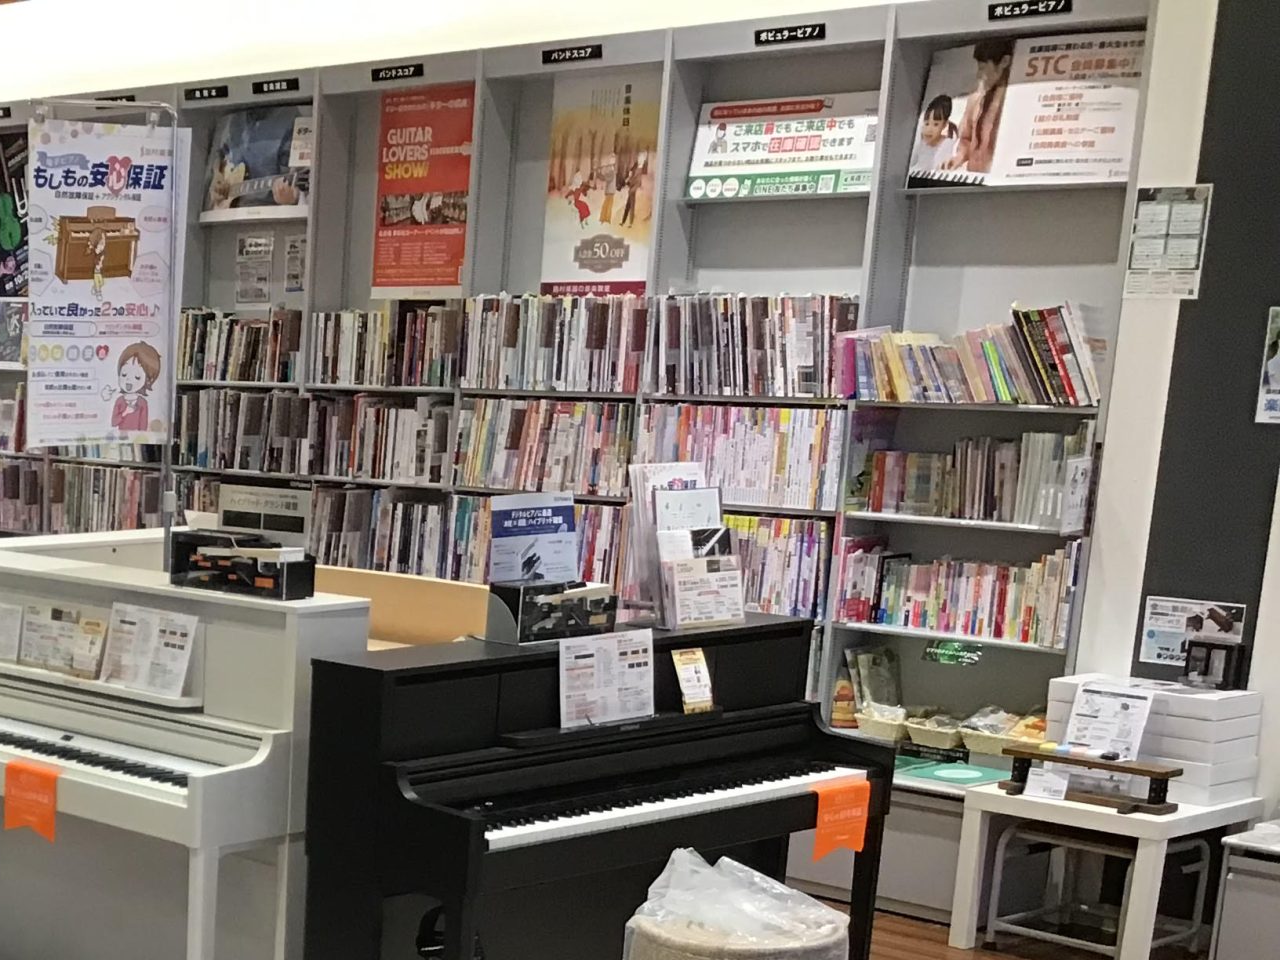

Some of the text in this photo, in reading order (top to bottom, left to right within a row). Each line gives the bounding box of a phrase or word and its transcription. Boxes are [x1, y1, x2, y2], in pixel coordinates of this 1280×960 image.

[994, 1, 1064, 16] ポピュラーピアノ
[759, 27, 820, 41] ポピュラーピアノ
[551, 48, 592, 60] バンドスコア
[1025, 54, 1069, 77] STC
[387, 126, 433, 145] GUITAR
[33, 161, 168, 190] もしもの安心保証
